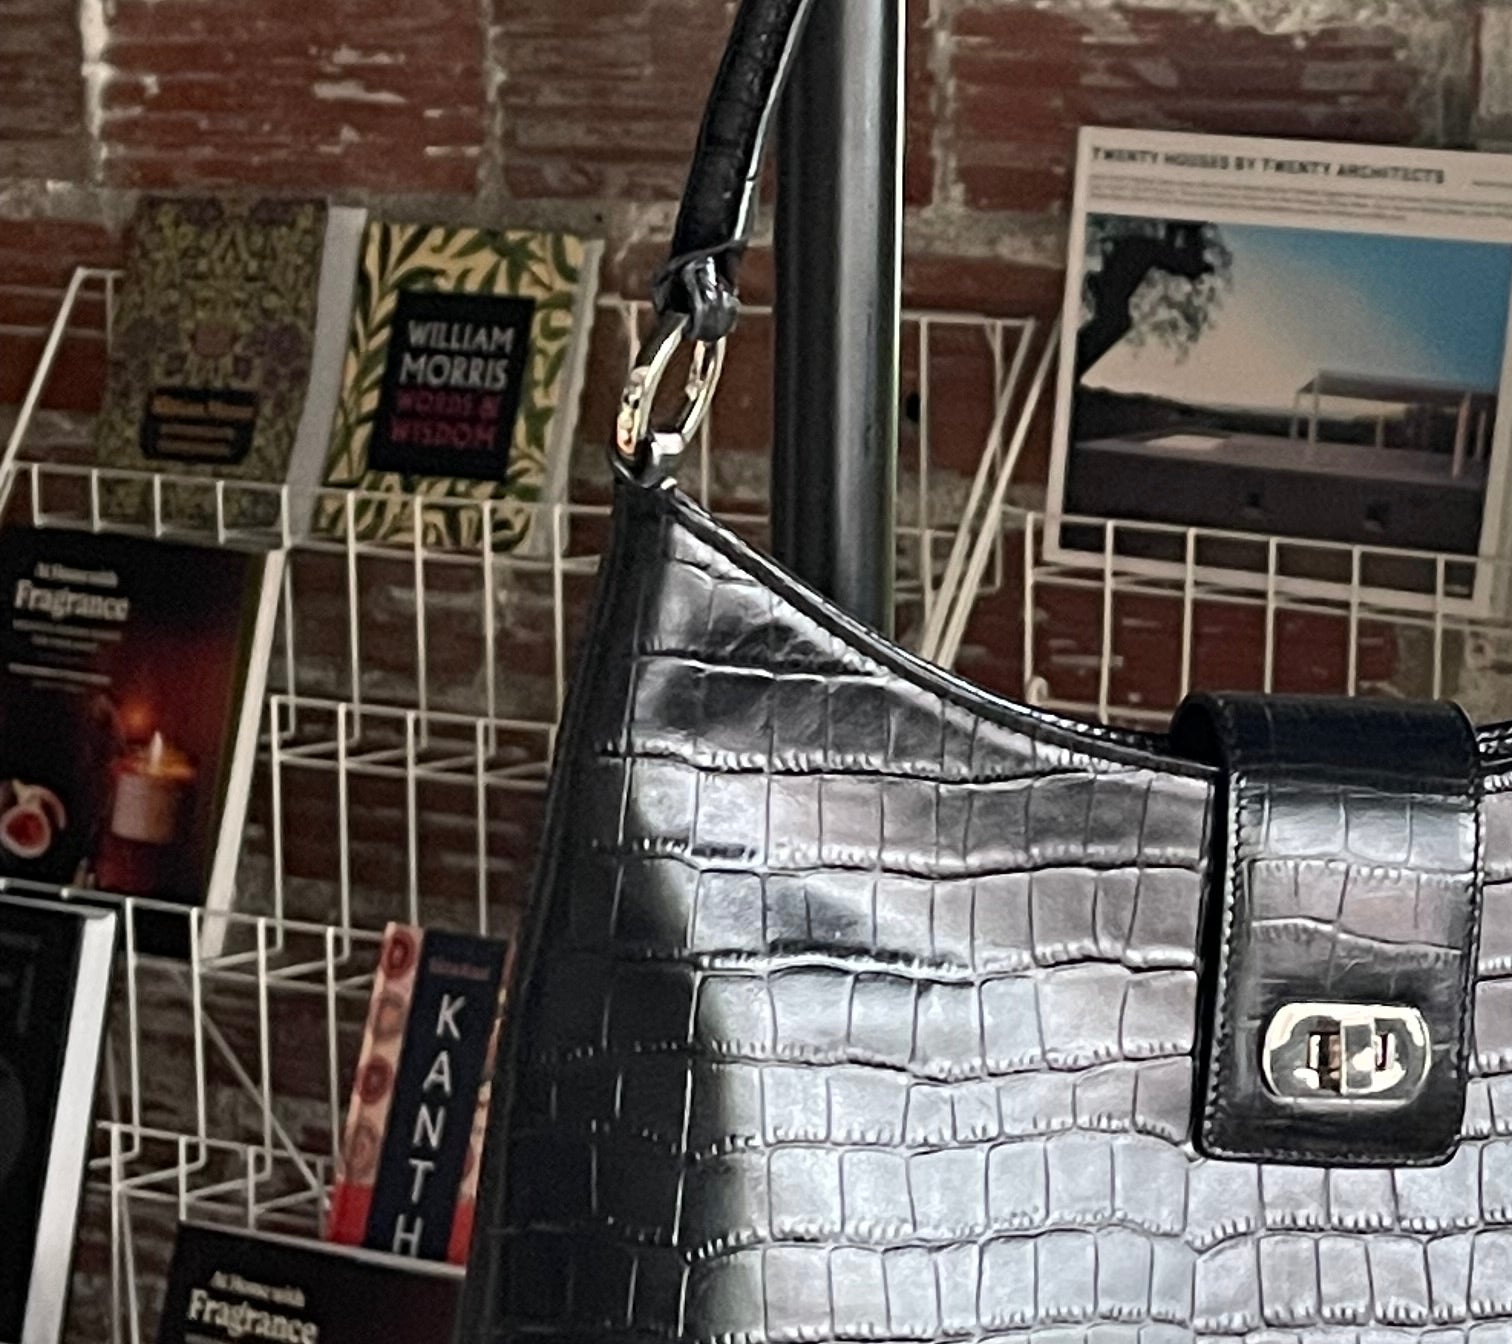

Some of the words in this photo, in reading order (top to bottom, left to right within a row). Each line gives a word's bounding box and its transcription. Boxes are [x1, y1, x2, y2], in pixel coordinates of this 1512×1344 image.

[1092, 146, 1158, 164] TWENTY
[1235, 156, 1256, 171] BY
[1263, 158, 1331, 175] TWENTY
[1336, 163, 1445, 184] ARCHITECTS
[408, 320, 515, 355] WILLIAM
[399, 352, 509, 390] MORRIS
[14, 578, 129, 621] Fragrance
